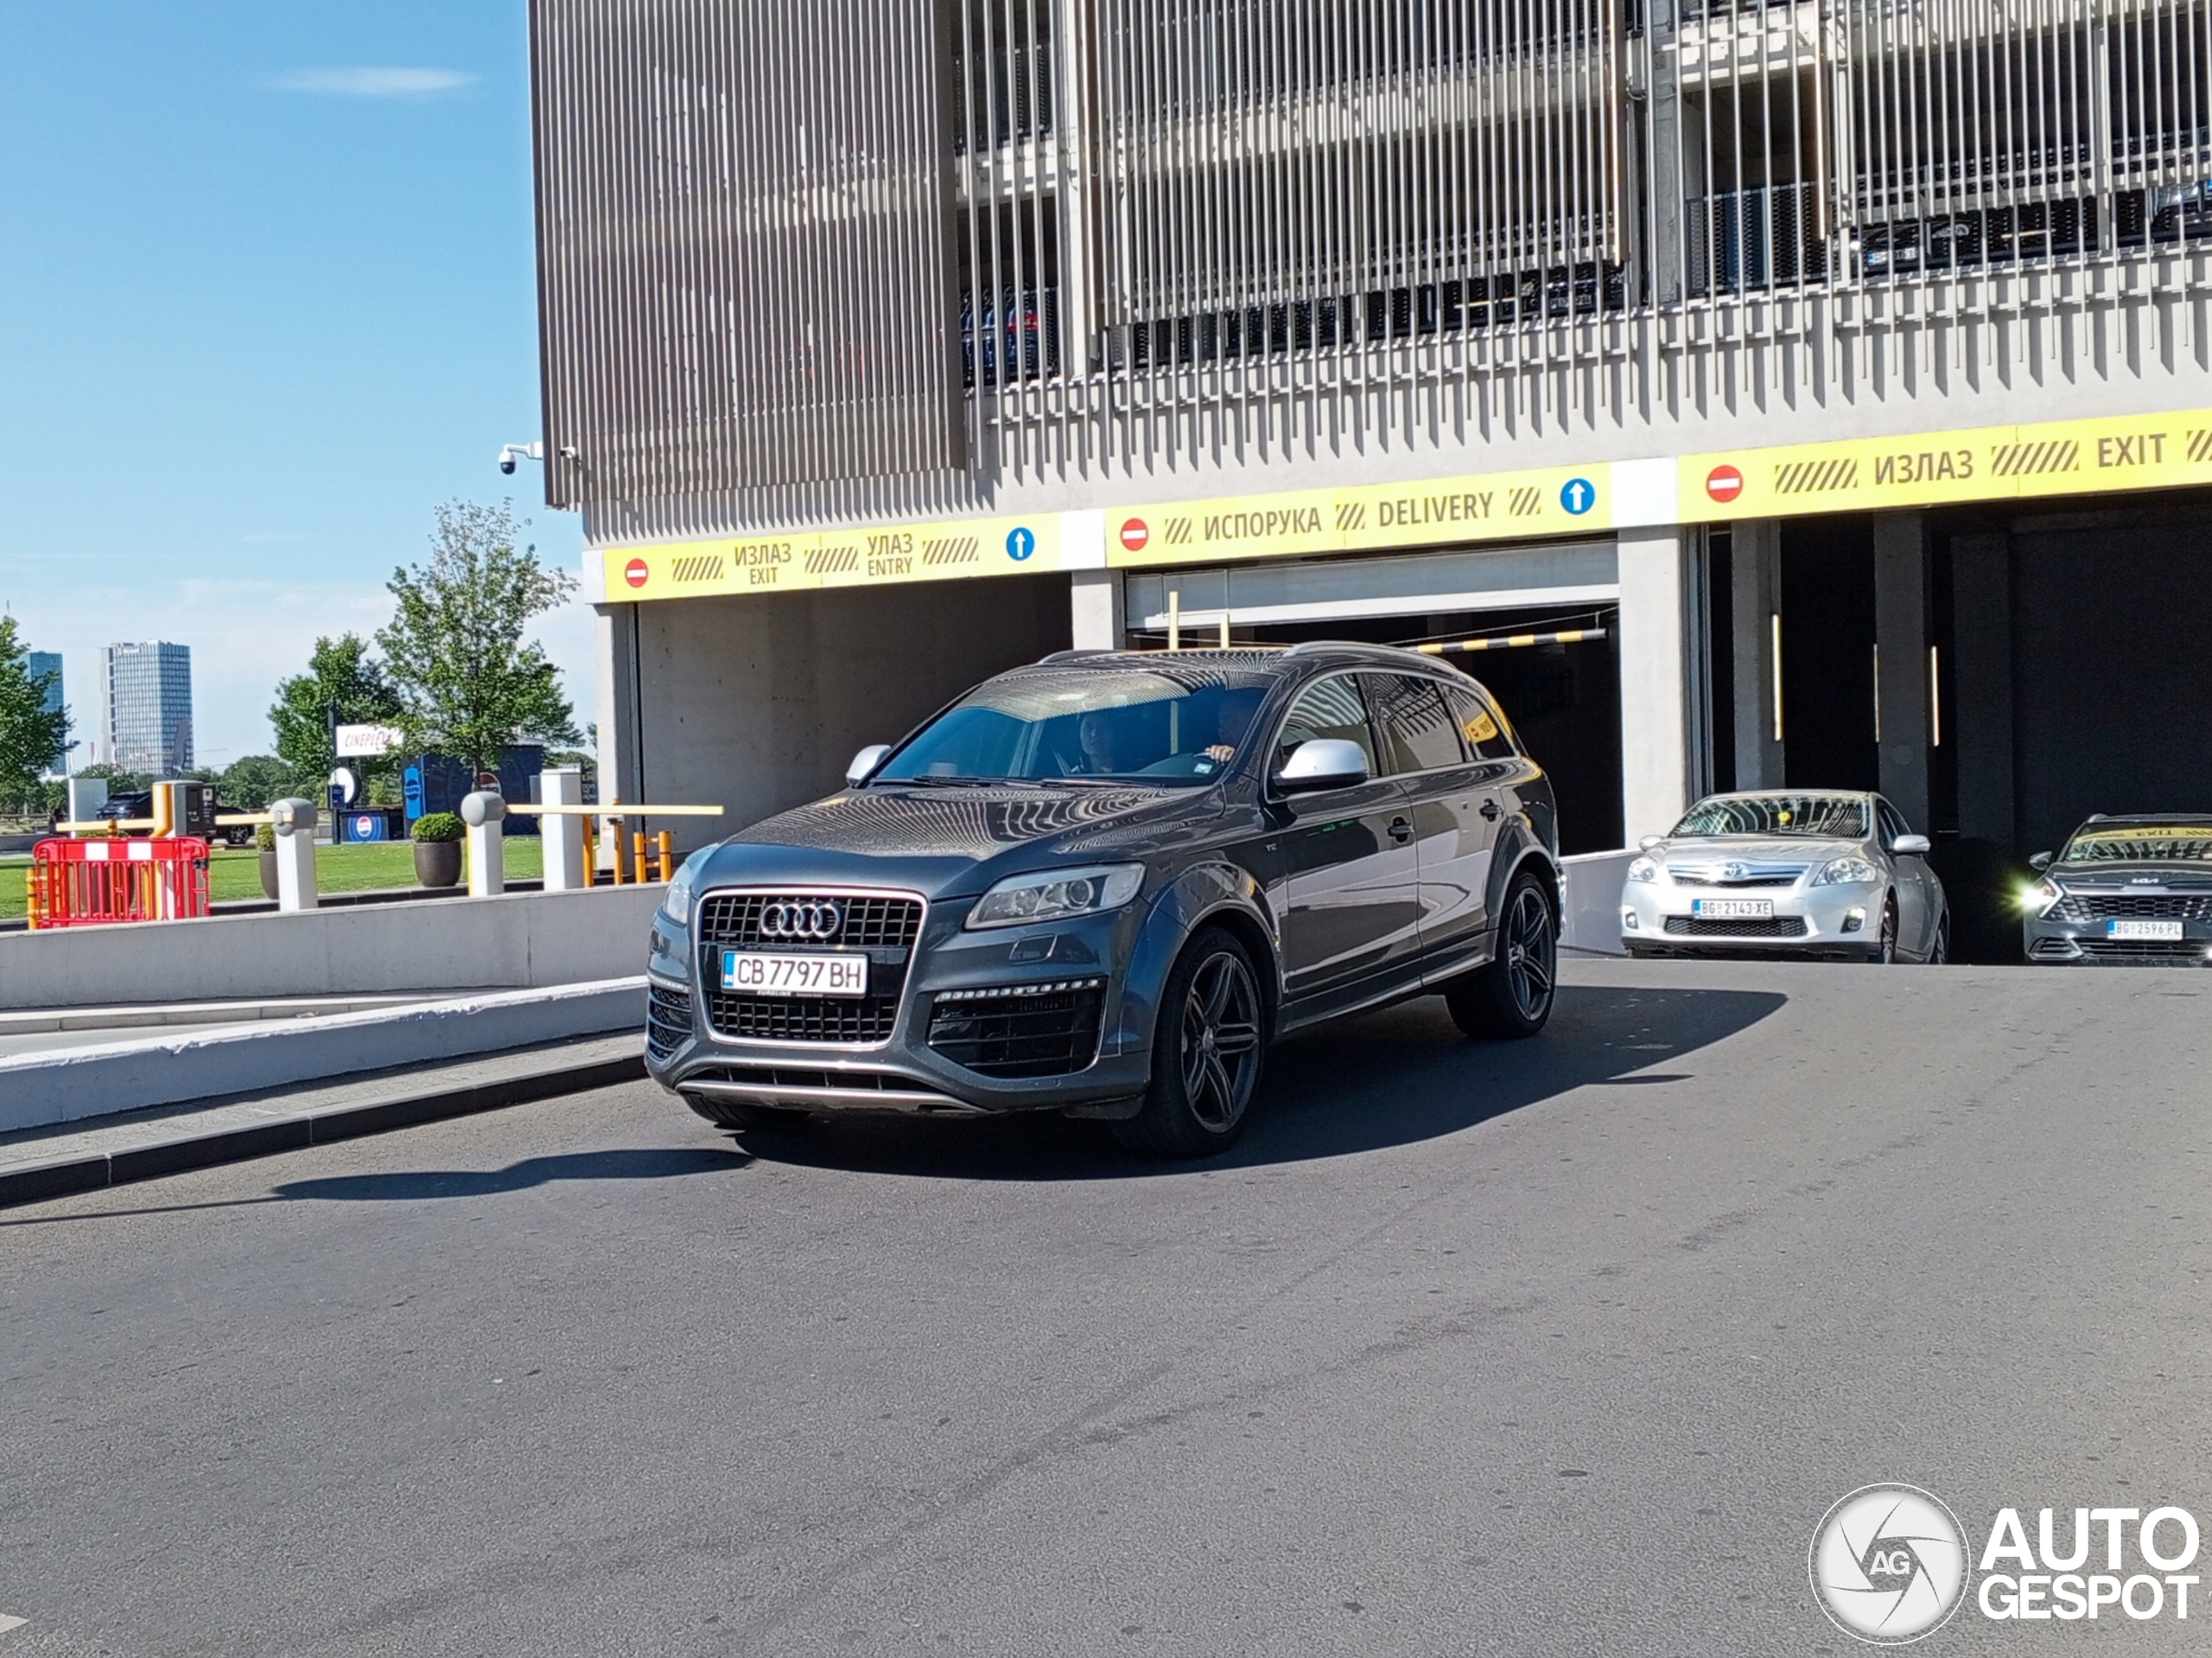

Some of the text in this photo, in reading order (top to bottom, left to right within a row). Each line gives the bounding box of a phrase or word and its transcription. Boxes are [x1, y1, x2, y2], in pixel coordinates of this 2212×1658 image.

[2097, 433, 2167, 468] EXIT
[1874, 449, 1974, 486] ИЗЛАЗ
[1378, 491, 1494, 527] DELIVERY
[1204, 506, 1322, 541] ИСПОРУКА
[734, 543, 792, 566] ИЗЛАЗ
[867, 533, 913, 556] УЛАЗ
[749, 567, 779, 585] EXIT
[868, 557, 913, 576] ENTRY
[1702, 902, 1715, 914] BG
[2116, 923, 2130, 934] BG
[738, 958, 861, 988] CB 7797 BH
